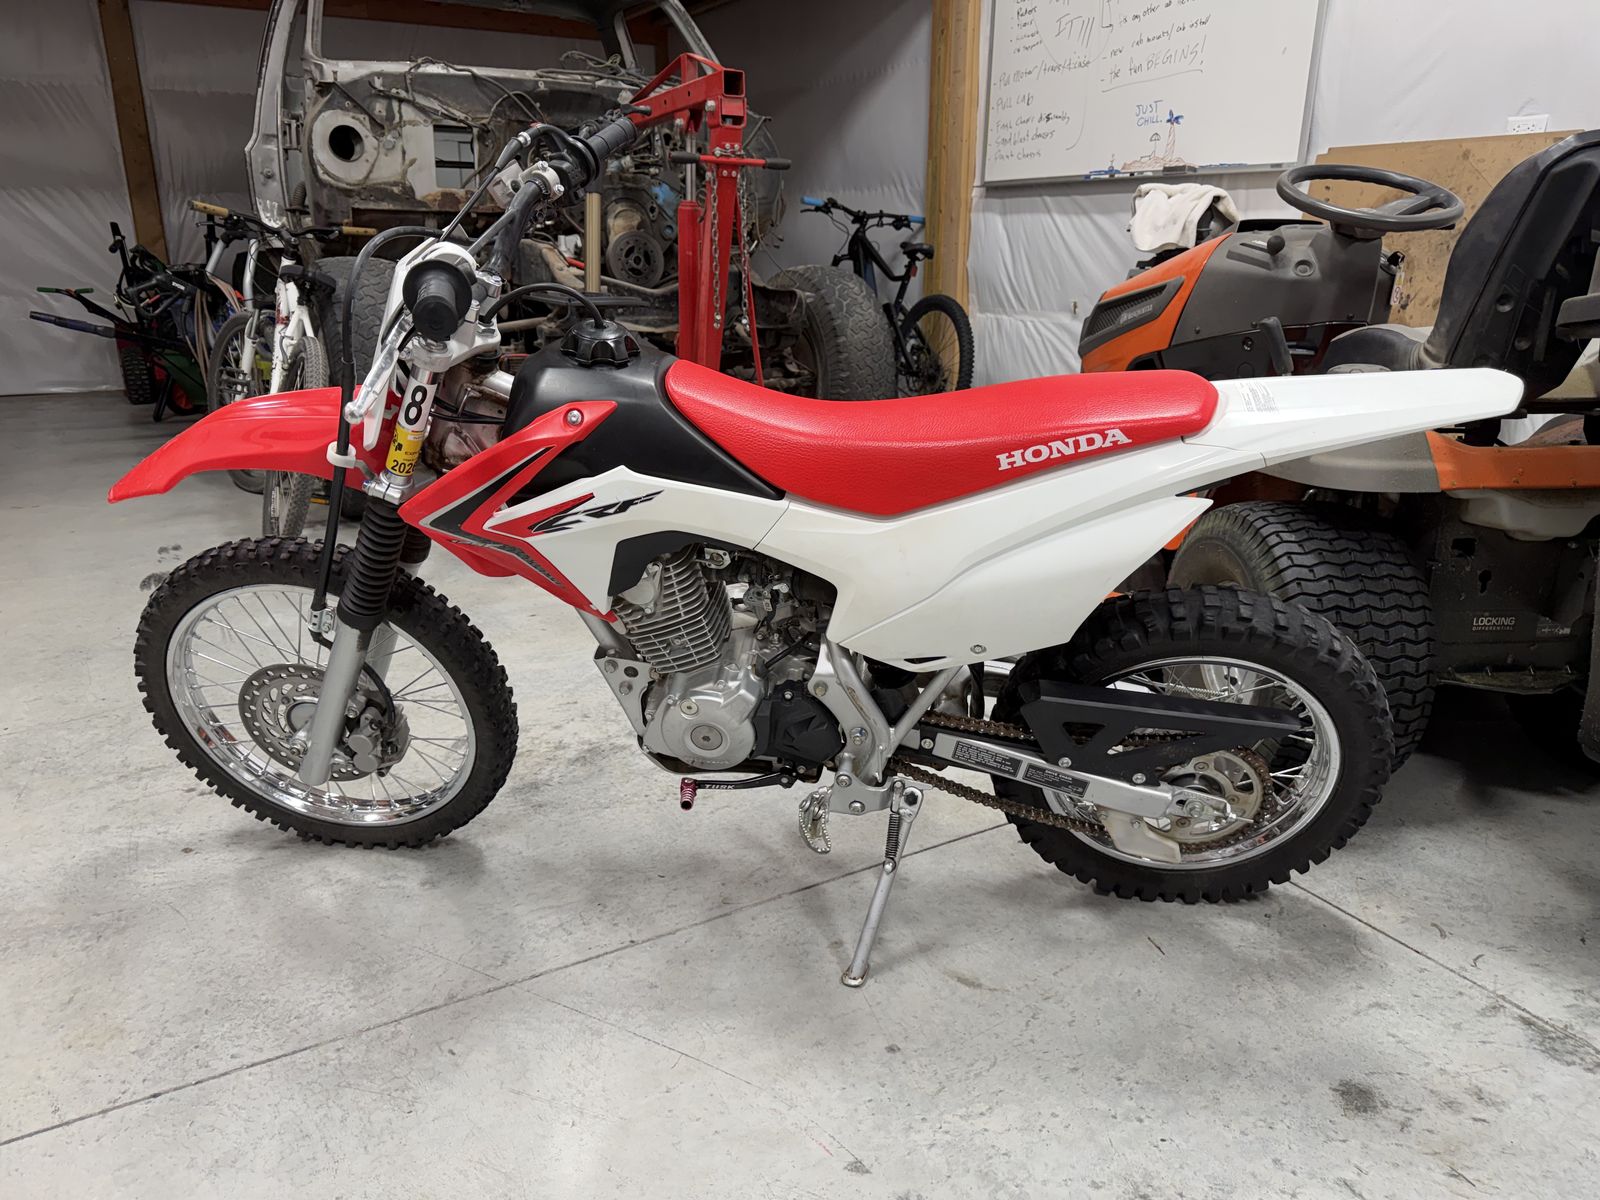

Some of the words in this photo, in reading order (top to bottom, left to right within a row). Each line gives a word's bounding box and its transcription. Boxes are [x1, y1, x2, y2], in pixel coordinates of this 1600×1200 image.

[1135, 99, 1164, 117] JUST
[404, 385, 428, 426] 8
[996, 428, 1133, 471] HONDA
[1473, 617, 1515, 626] LOCKING
